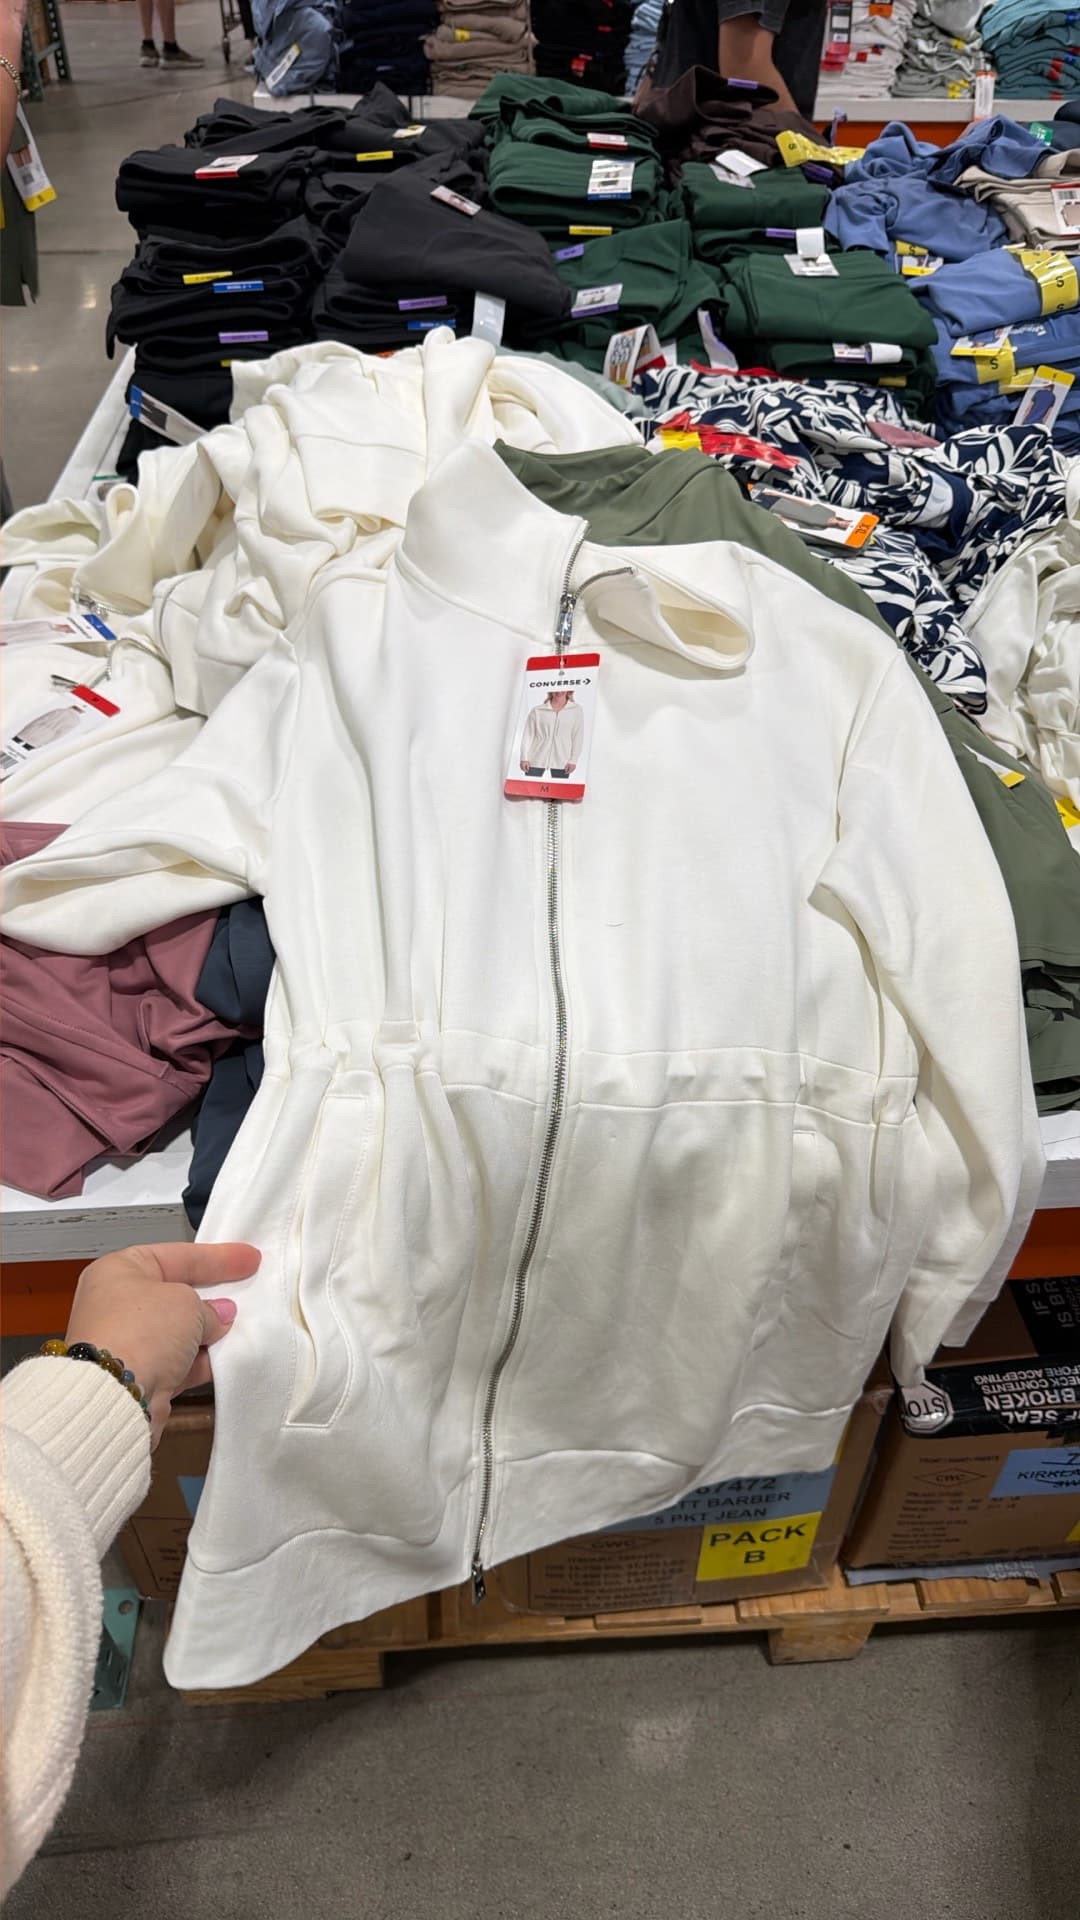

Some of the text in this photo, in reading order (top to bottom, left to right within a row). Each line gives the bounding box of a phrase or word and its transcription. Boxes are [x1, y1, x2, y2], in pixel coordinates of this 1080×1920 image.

[1056, 276, 1064, 287] S
[990, 358, 999, 369] S
[529, 678, 582, 688] CONVERSE
[540, 785, 549, 793] M
[974, 1369, 1044, 1386] ACCEPTING
[981, 1377, 1050, 1395] CONTENTS
[904, 1396, 945, 1418] STO
[983, 1387, 1076, 1411] BROKEN
[1001, 1409, 1060, 1425] SEAL
[708, 1492, 792, 1508] BARBER
[671, 1512, 708, 1523] PKT
[715, 1507, 768, 1520] JEAN
[709, 1522, 808, 1547] PACK
[744, 1551, 766, 1564] B
